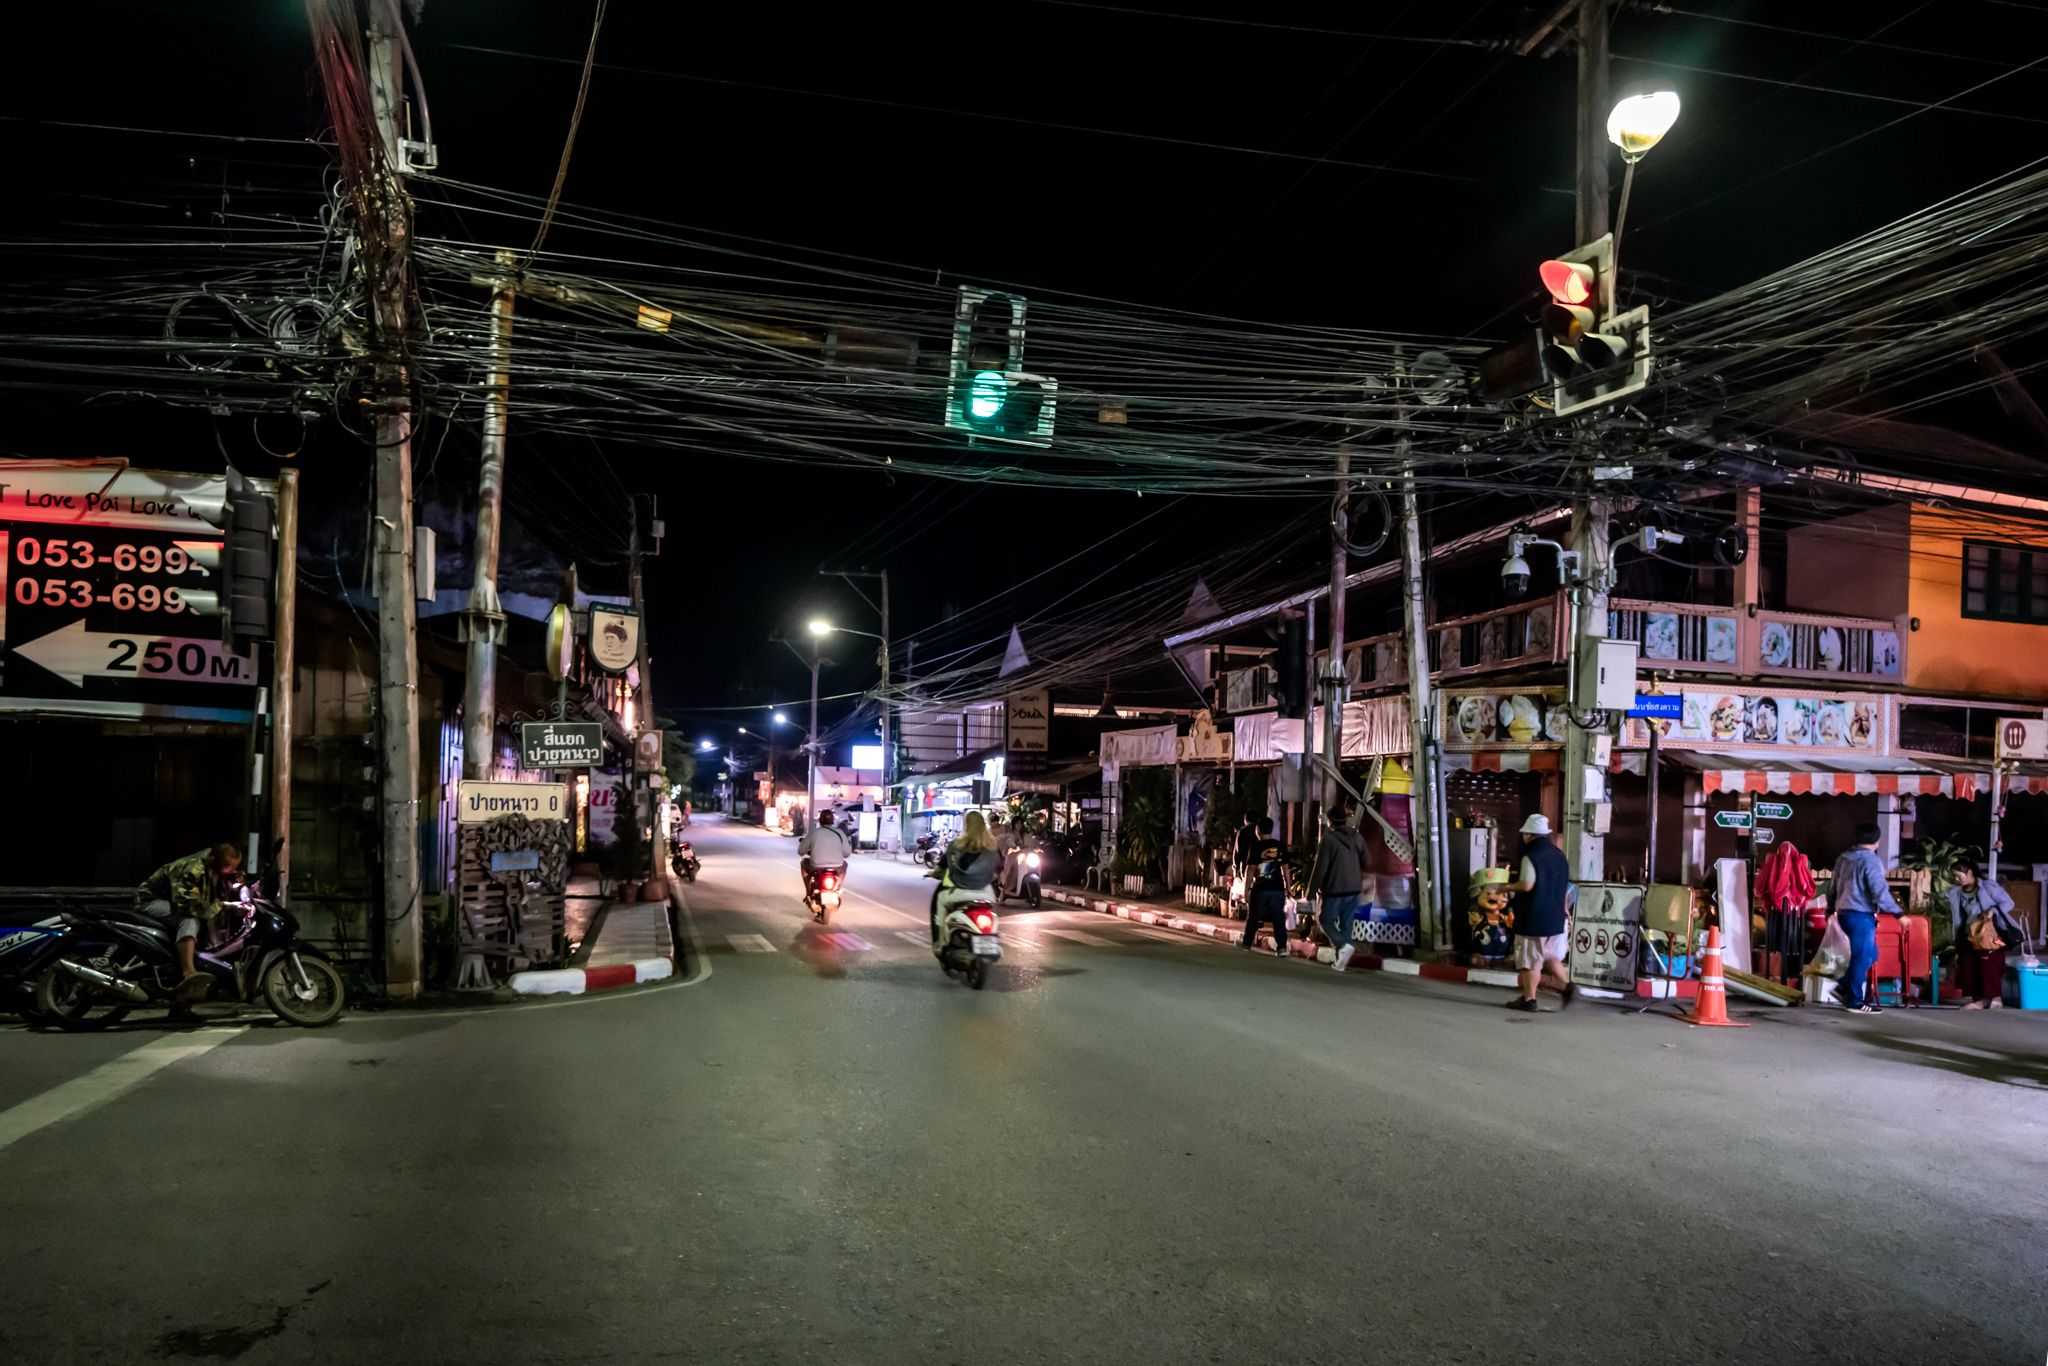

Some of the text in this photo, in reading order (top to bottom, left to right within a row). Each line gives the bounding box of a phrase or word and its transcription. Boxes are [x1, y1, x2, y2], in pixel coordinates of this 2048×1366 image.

[25, 489, 76, 510] Love
[85, 492, 119, 512] Pai
[131, 496, 178, 517] Love
[15, 576, 201, 616] 053-699
[543, 725, 585, 746] สี่แยก
[528, 746, 600, 762] ปายหนาว
[469, 793, 538, 811] ปายหนาว
